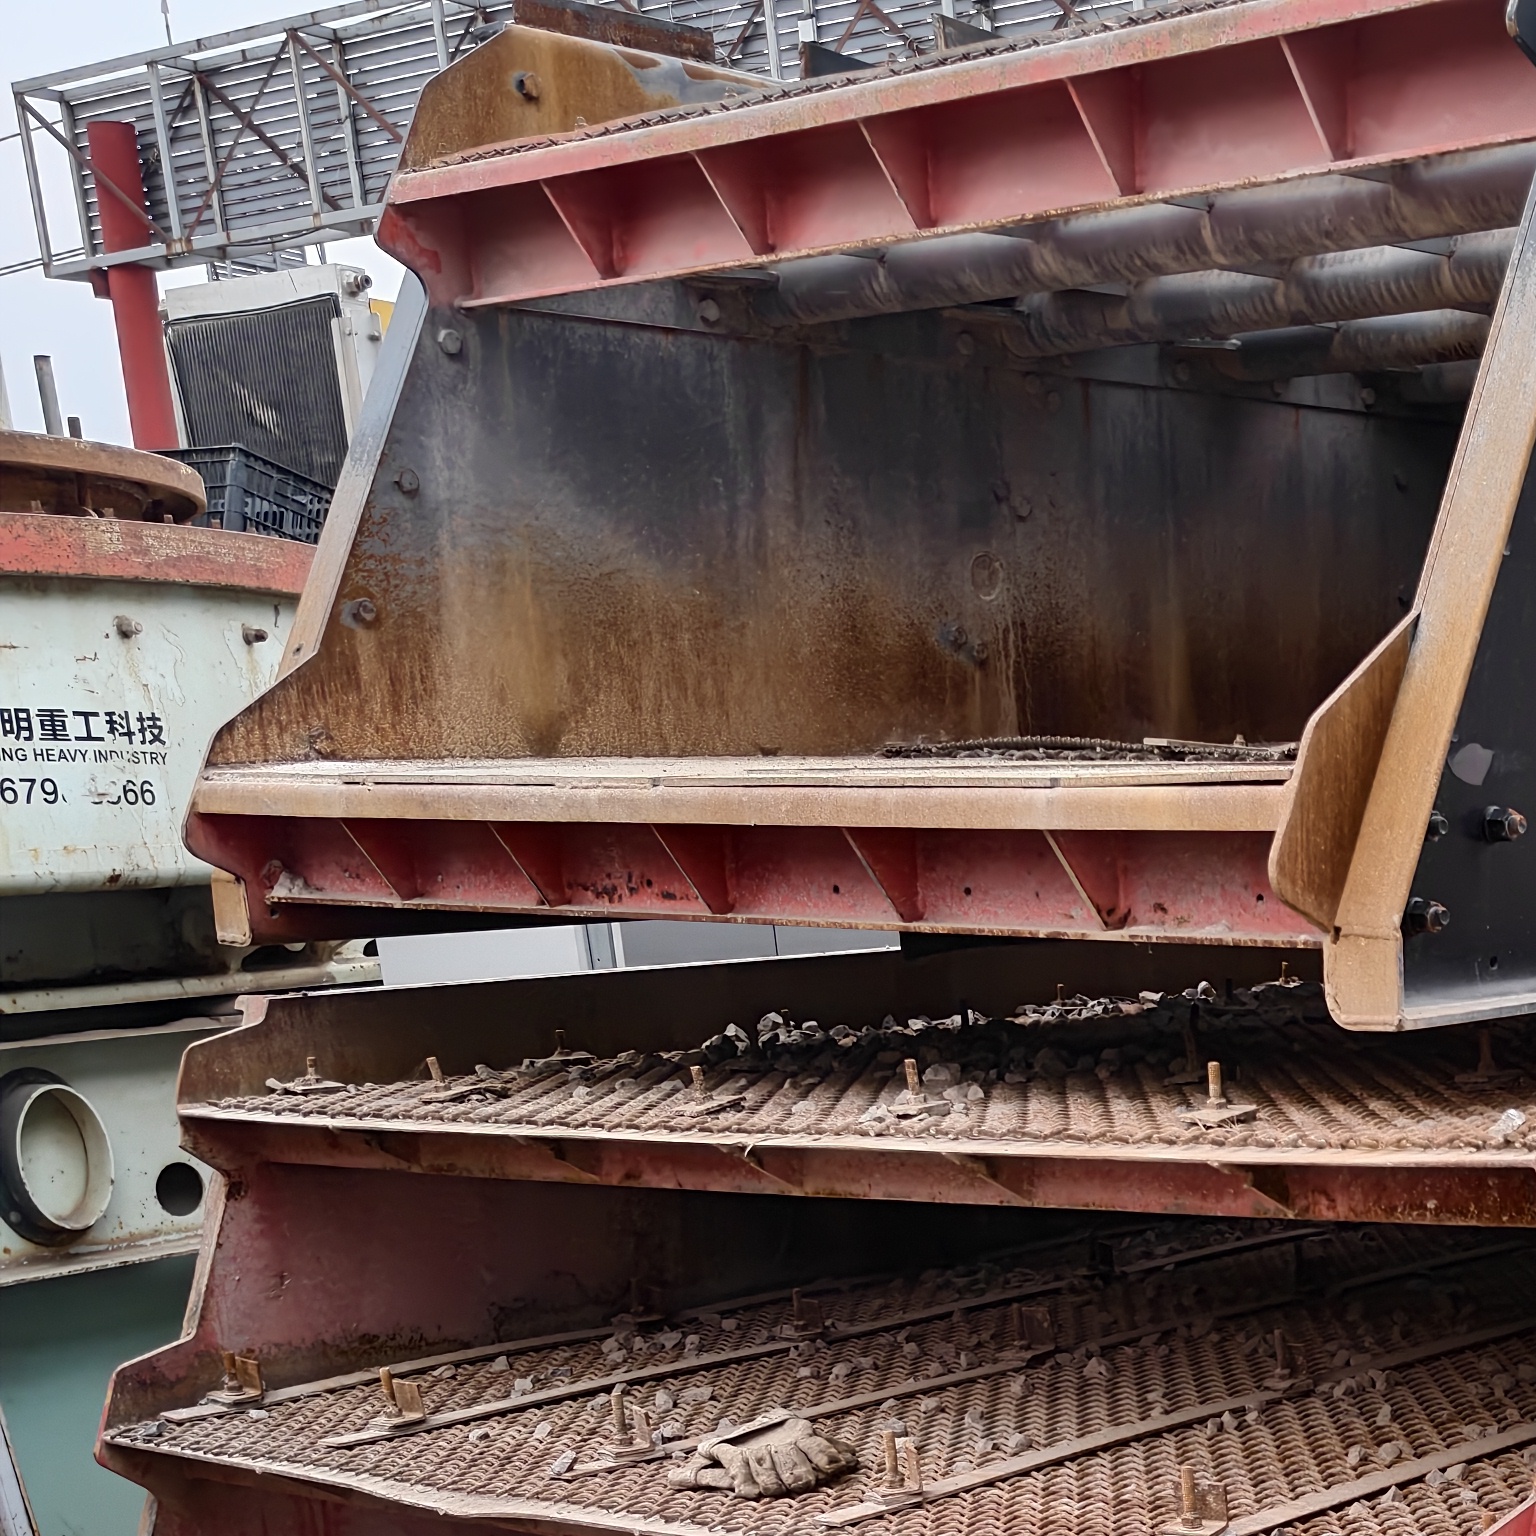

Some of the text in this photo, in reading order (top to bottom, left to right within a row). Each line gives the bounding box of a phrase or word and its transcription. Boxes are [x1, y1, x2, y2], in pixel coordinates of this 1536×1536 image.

[0, 708, 166, 746] 明重工科技
[33, 748, 88, 763] HEAVY
